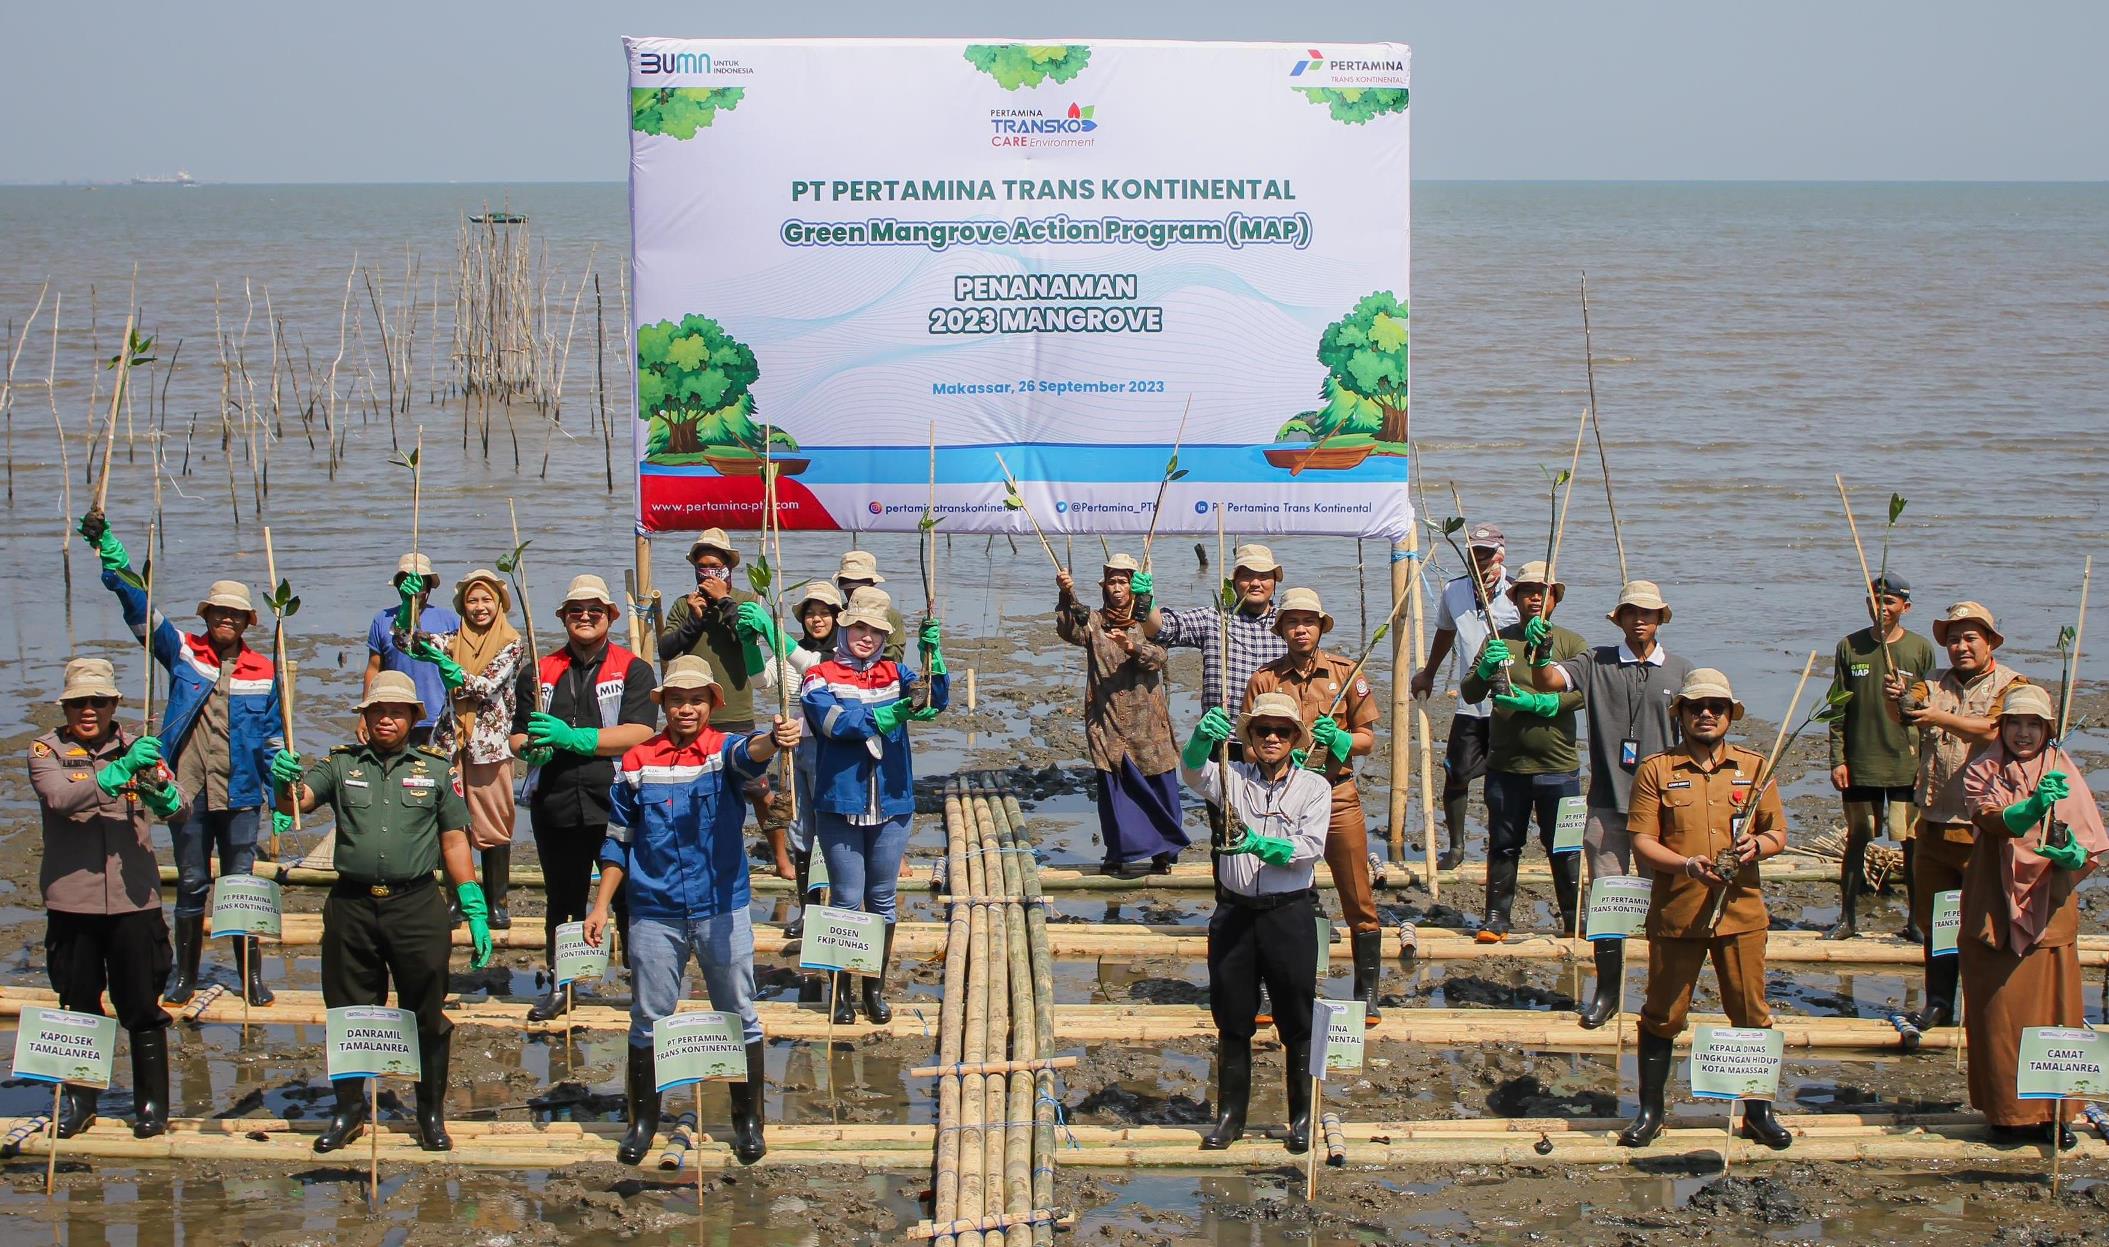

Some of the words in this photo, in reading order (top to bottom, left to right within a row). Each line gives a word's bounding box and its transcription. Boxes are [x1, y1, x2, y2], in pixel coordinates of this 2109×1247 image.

[713, 67, 754, 75] INDONESIA
[1330, 60, 1404, 71] PERTAMINA
[990, 109, 1043, 117] PERTAMINA
[991, 136, 1028, 147] CARE
[1029, 137, 1095, 148] Environment
[792, 181, 825, 201] PT
[833, 180, 995, 201] PERTAMINA
[1002, 179, 1095, 201] TRANS
[1102, 179, 1296, 200] KONTINENTAL
[783, 221, 866, 246] Green
[869, 220, 1009, 250] Mangrove
[1012, 216, 1100, 242] Action
[1105, 218, 1224, 248] Program
[1226, 213, 1311, 248] (MAP)
[955, 274, 1137, 301] PENANAMAN
[928, 307, 998, 334] 2023
[999, 306, 1163, 333] MANGROVE
[932, 383, 1014, 395] Makassar,
[1018, 380, 1036, 392] 26
[1039, 380, 1125, 395] September
[1128, 380, 1165, 393] 2023
[651, 499, 800, 514] www.pertamina-pt.com
[1212, 502, 1224, 511] P
[1228, 502, 1280, 513] Pertamina
[1284, 502, 1310, 513] Trans
[1314, 502, 1372, 513] Kontinental
[232, 893, 271, 904] PERTAMINA
[234, 903, 280, 915] KONTINENTAL
[1591, 905, 1611, 913] TRANS
[829, 926, 859, 938] DOSEN
[817, 936, 836, 945] FKIP
[838, 938, 869, 951] UNHAS
[561, 949, 608, 959] KONTINENTAL
[40, 1031, 94, 1046] KAPOLSEK
[347, 1029, 402, 1039] DANRAMIL
[667, 1039, 676, 1047] PT
[678, 1034, 728, 1044] PERTAMINA
[29, 1042, 101, 1060] TAMALANREA
[340, 1042, 409, 1053] TAMALANREA
[656, 1048, 680, 1061] TRANS
[681, 1044, 743, 1054] KONTINENTAL
[1709, 1044, 1741, 1053] KEPALA
[1743, 1045, 1766, 1053] DINAS
[1695, 1053, 1751, 1064] LINGKUNGAN
[1752, 1056, 1778, 1065] HIDUP
[2047, 1049, 2084, 1059] CAMAT
[1701, 1064, 1726, 1073] KOTA
[1727, 1066, 1769, 1075] MAKASSAR
[2030, 1062, 2100, 1073] TAMALANREA
